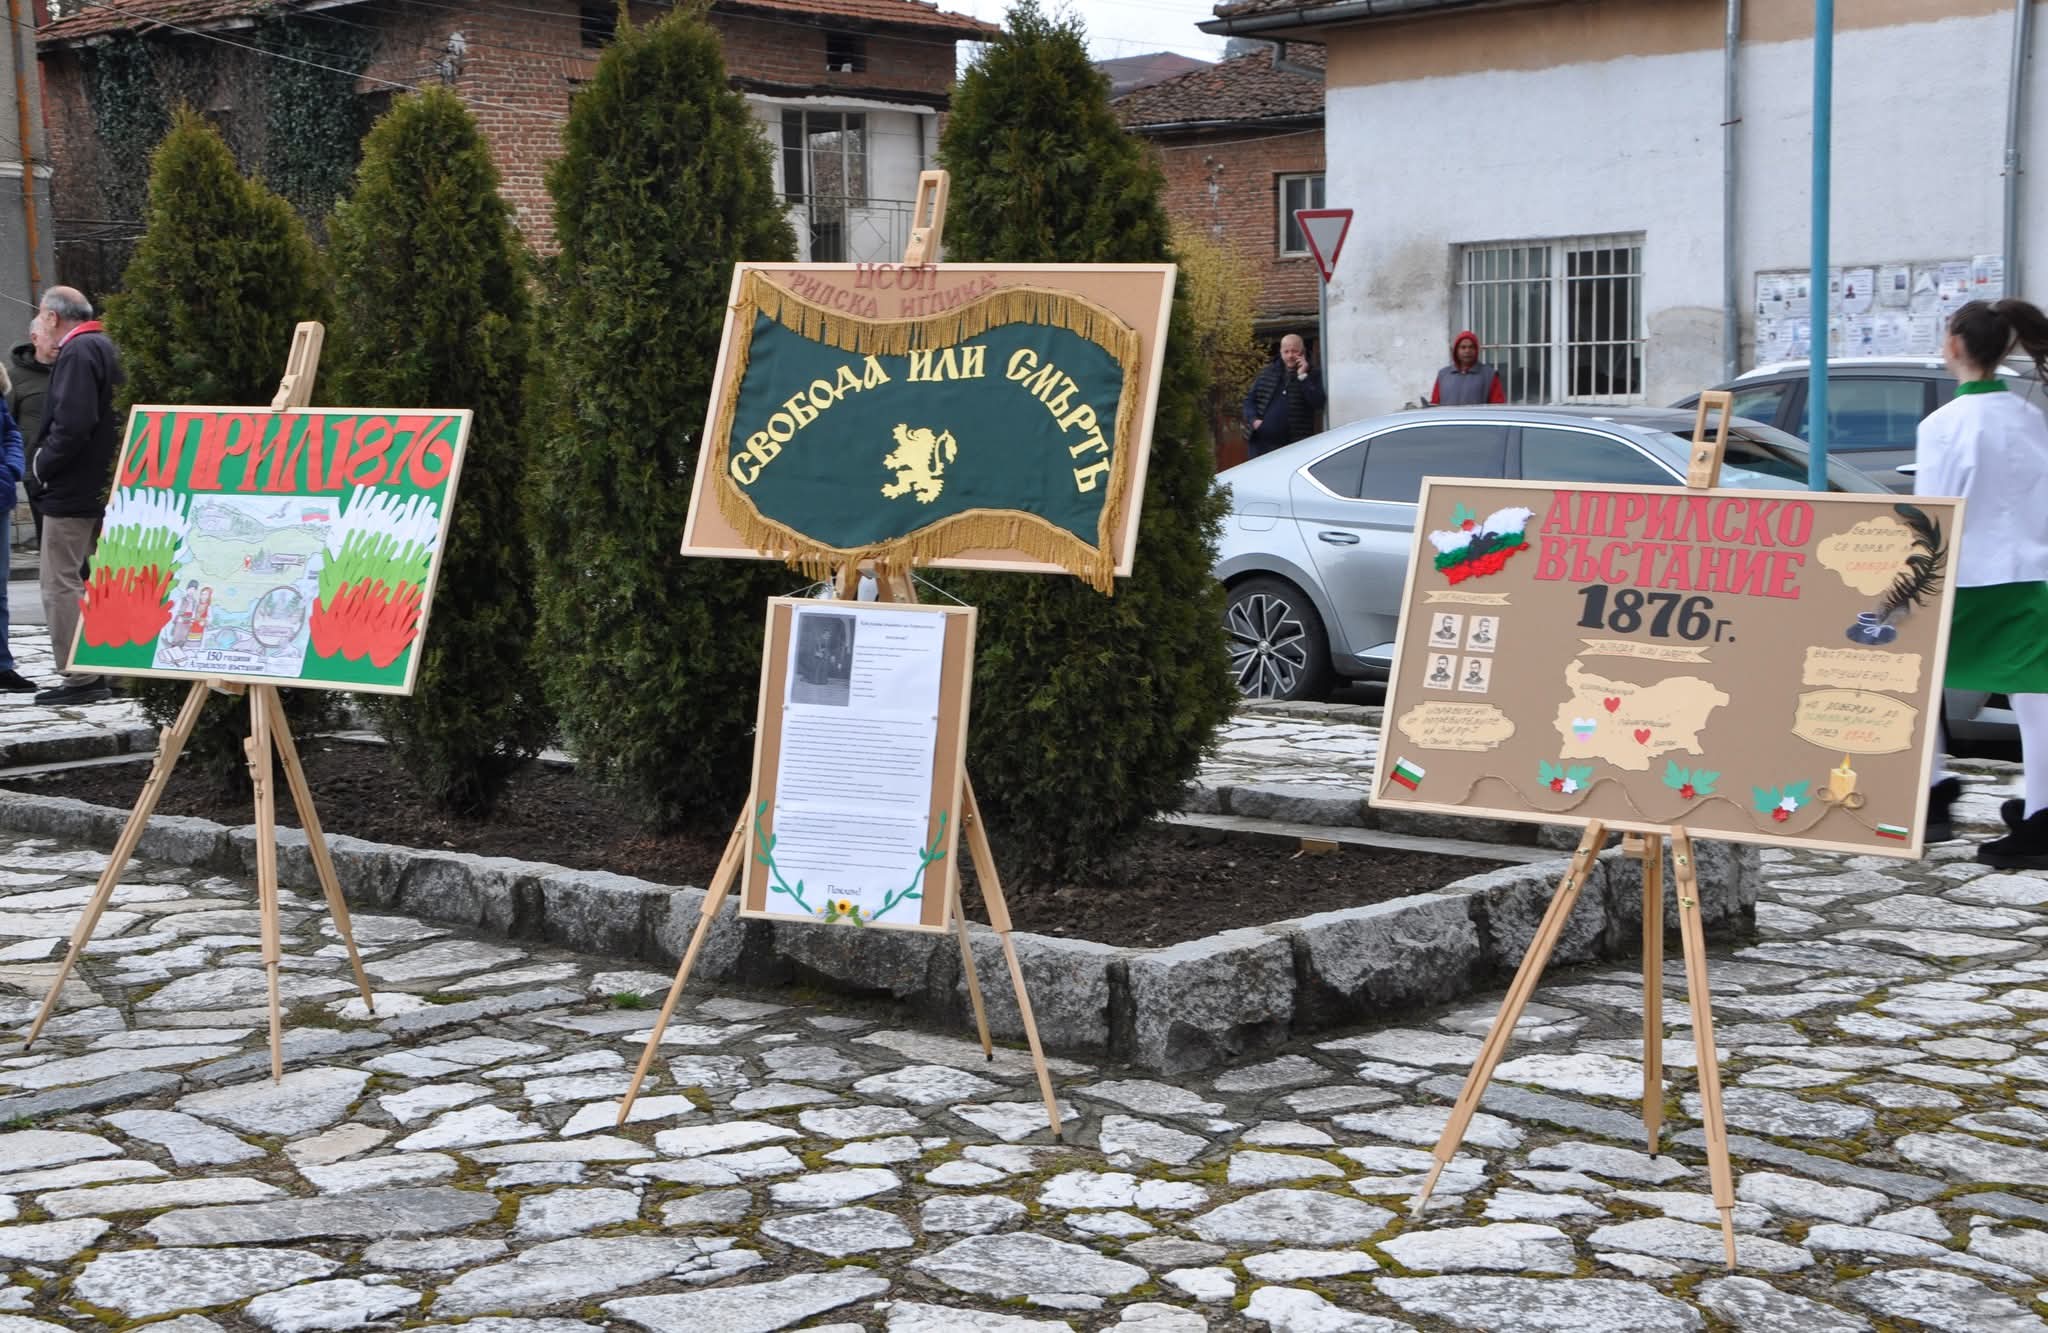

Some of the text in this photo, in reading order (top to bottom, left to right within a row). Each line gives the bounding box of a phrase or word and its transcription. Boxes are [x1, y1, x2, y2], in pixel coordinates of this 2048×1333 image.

[854, 263, 937, 290] ЦСОП
[730, 345, 1113, 494] СВОБОДА ИЛИ СМЪРТЬ
[120, 411, 454, 493] АПРИЛ 1876
[1539, 489, 1815, 548] АПРИЛСКО
[1533, 534, 1806, 600] ВЪСТАНИЕ
[206, 650, 223, 662] 150
